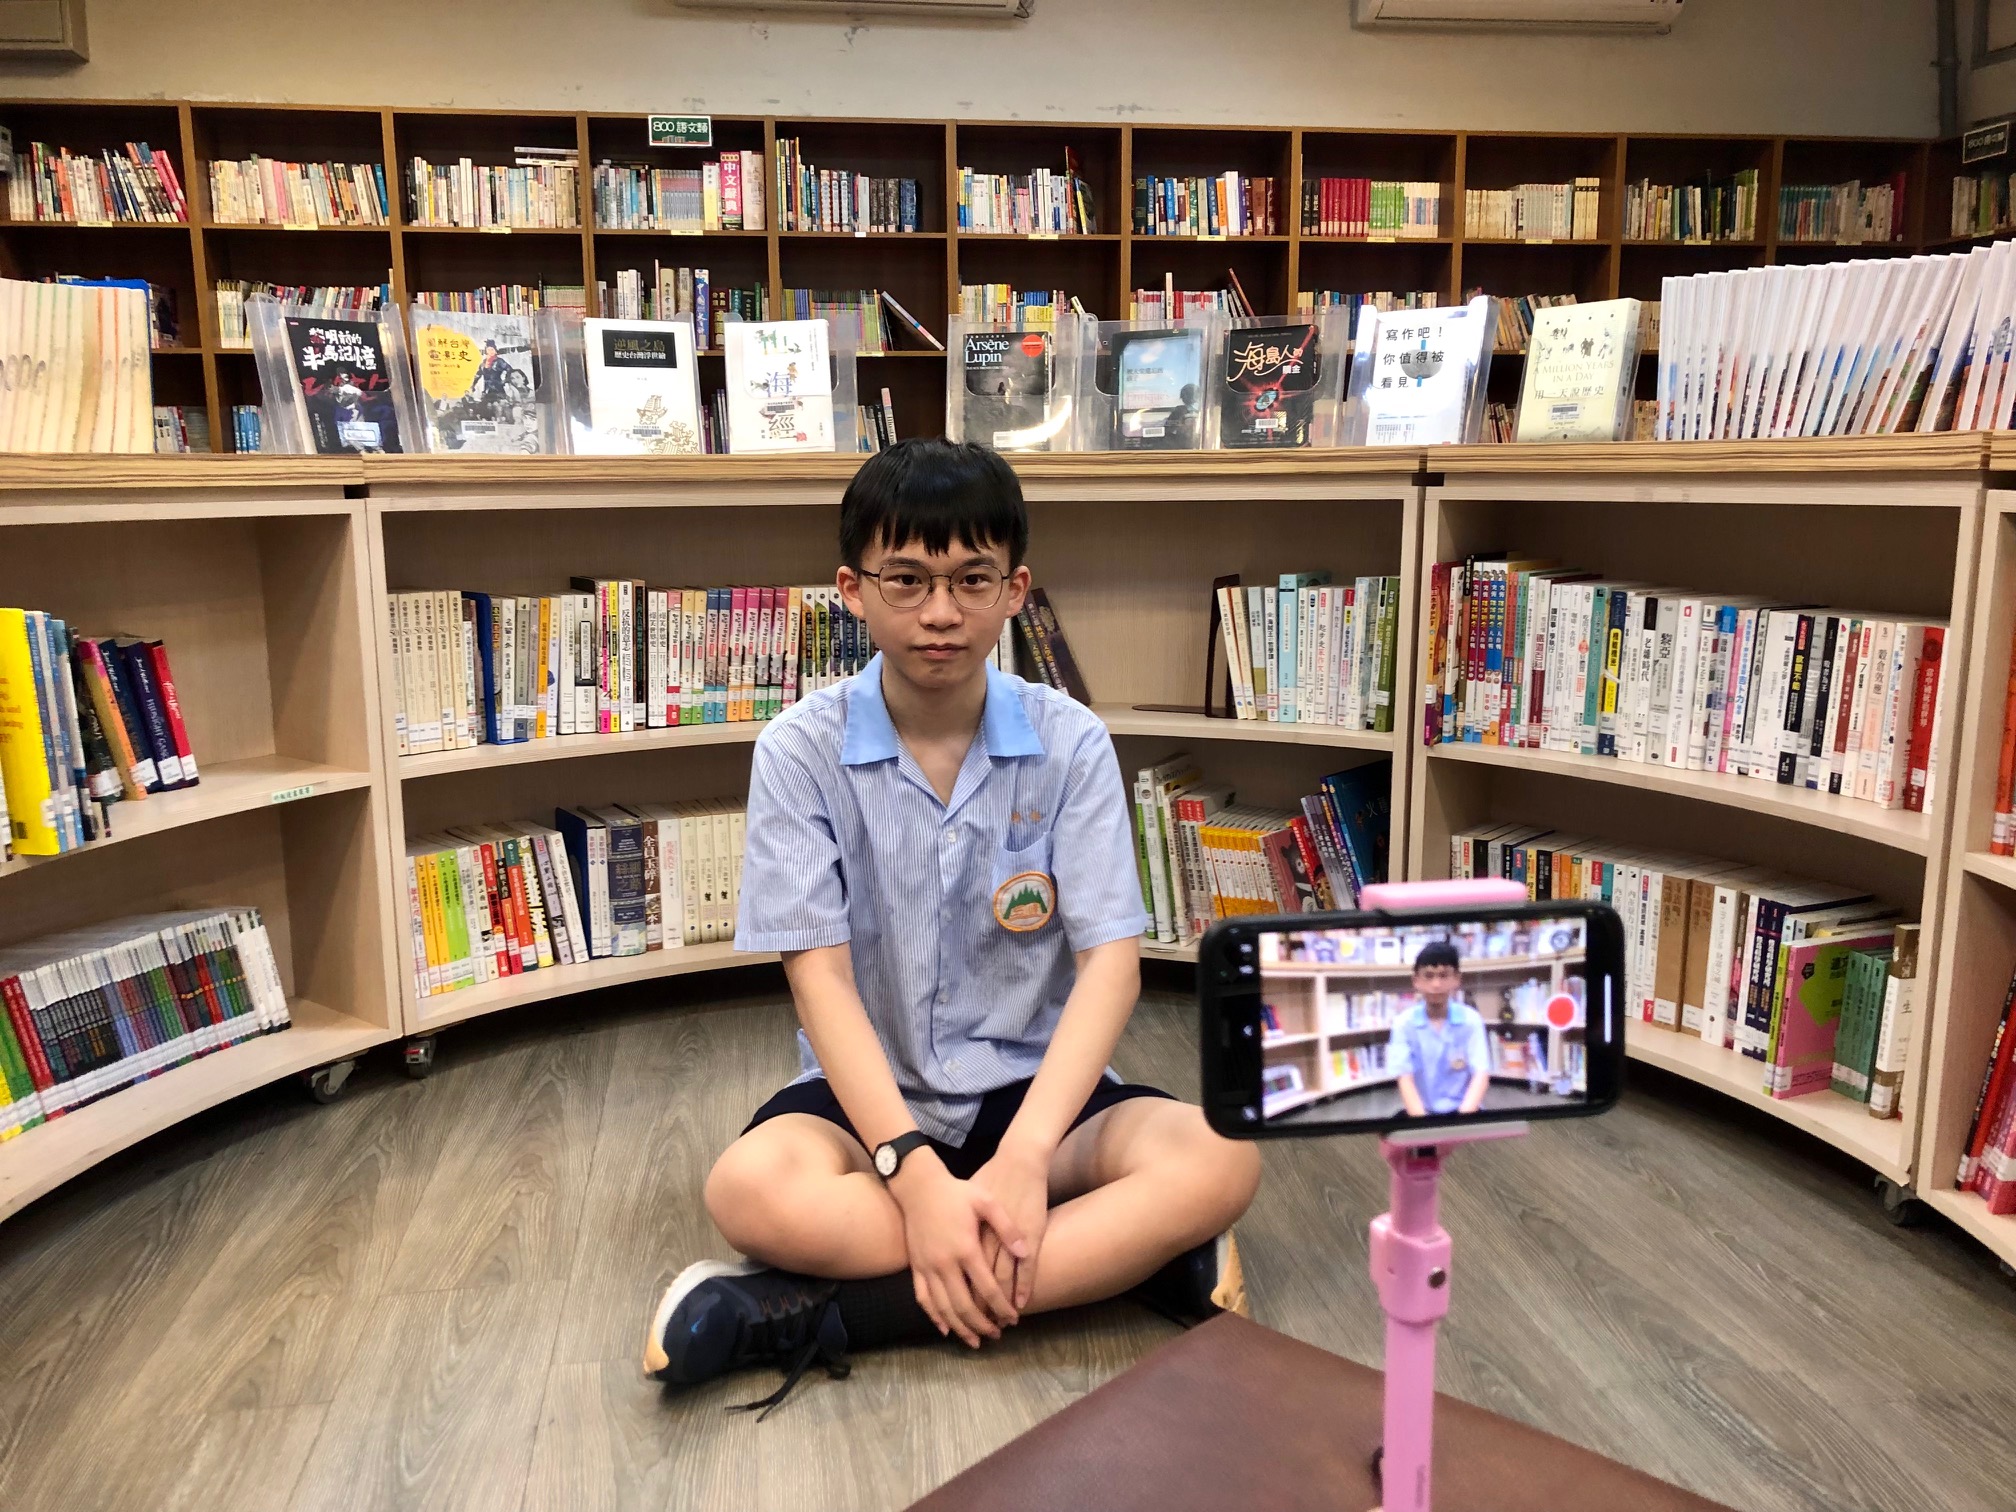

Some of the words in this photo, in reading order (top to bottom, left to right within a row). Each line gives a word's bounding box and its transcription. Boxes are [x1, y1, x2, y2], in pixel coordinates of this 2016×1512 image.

[653, 121, 674, 132] 800
[677, 122, 708, 133] 語文類
[309, 327, 362, 345] 黎明前的
[614, 338, 665, 352] 逆風之島
[965, 338, 1010, 350] Arsène
[302, 344, 376, 371] 半島記憶
[428, 349, 472, 362] 電影史
[965, 351, 1002, 366] Lupin
[1383, 351, 1445, 365] 你值得被
[1381, 377, 1409, 389] 看見
[1534, 385, 1604, 400] 用一天說歷史
[1873, 649, 1888, 695] 穀倉效應
